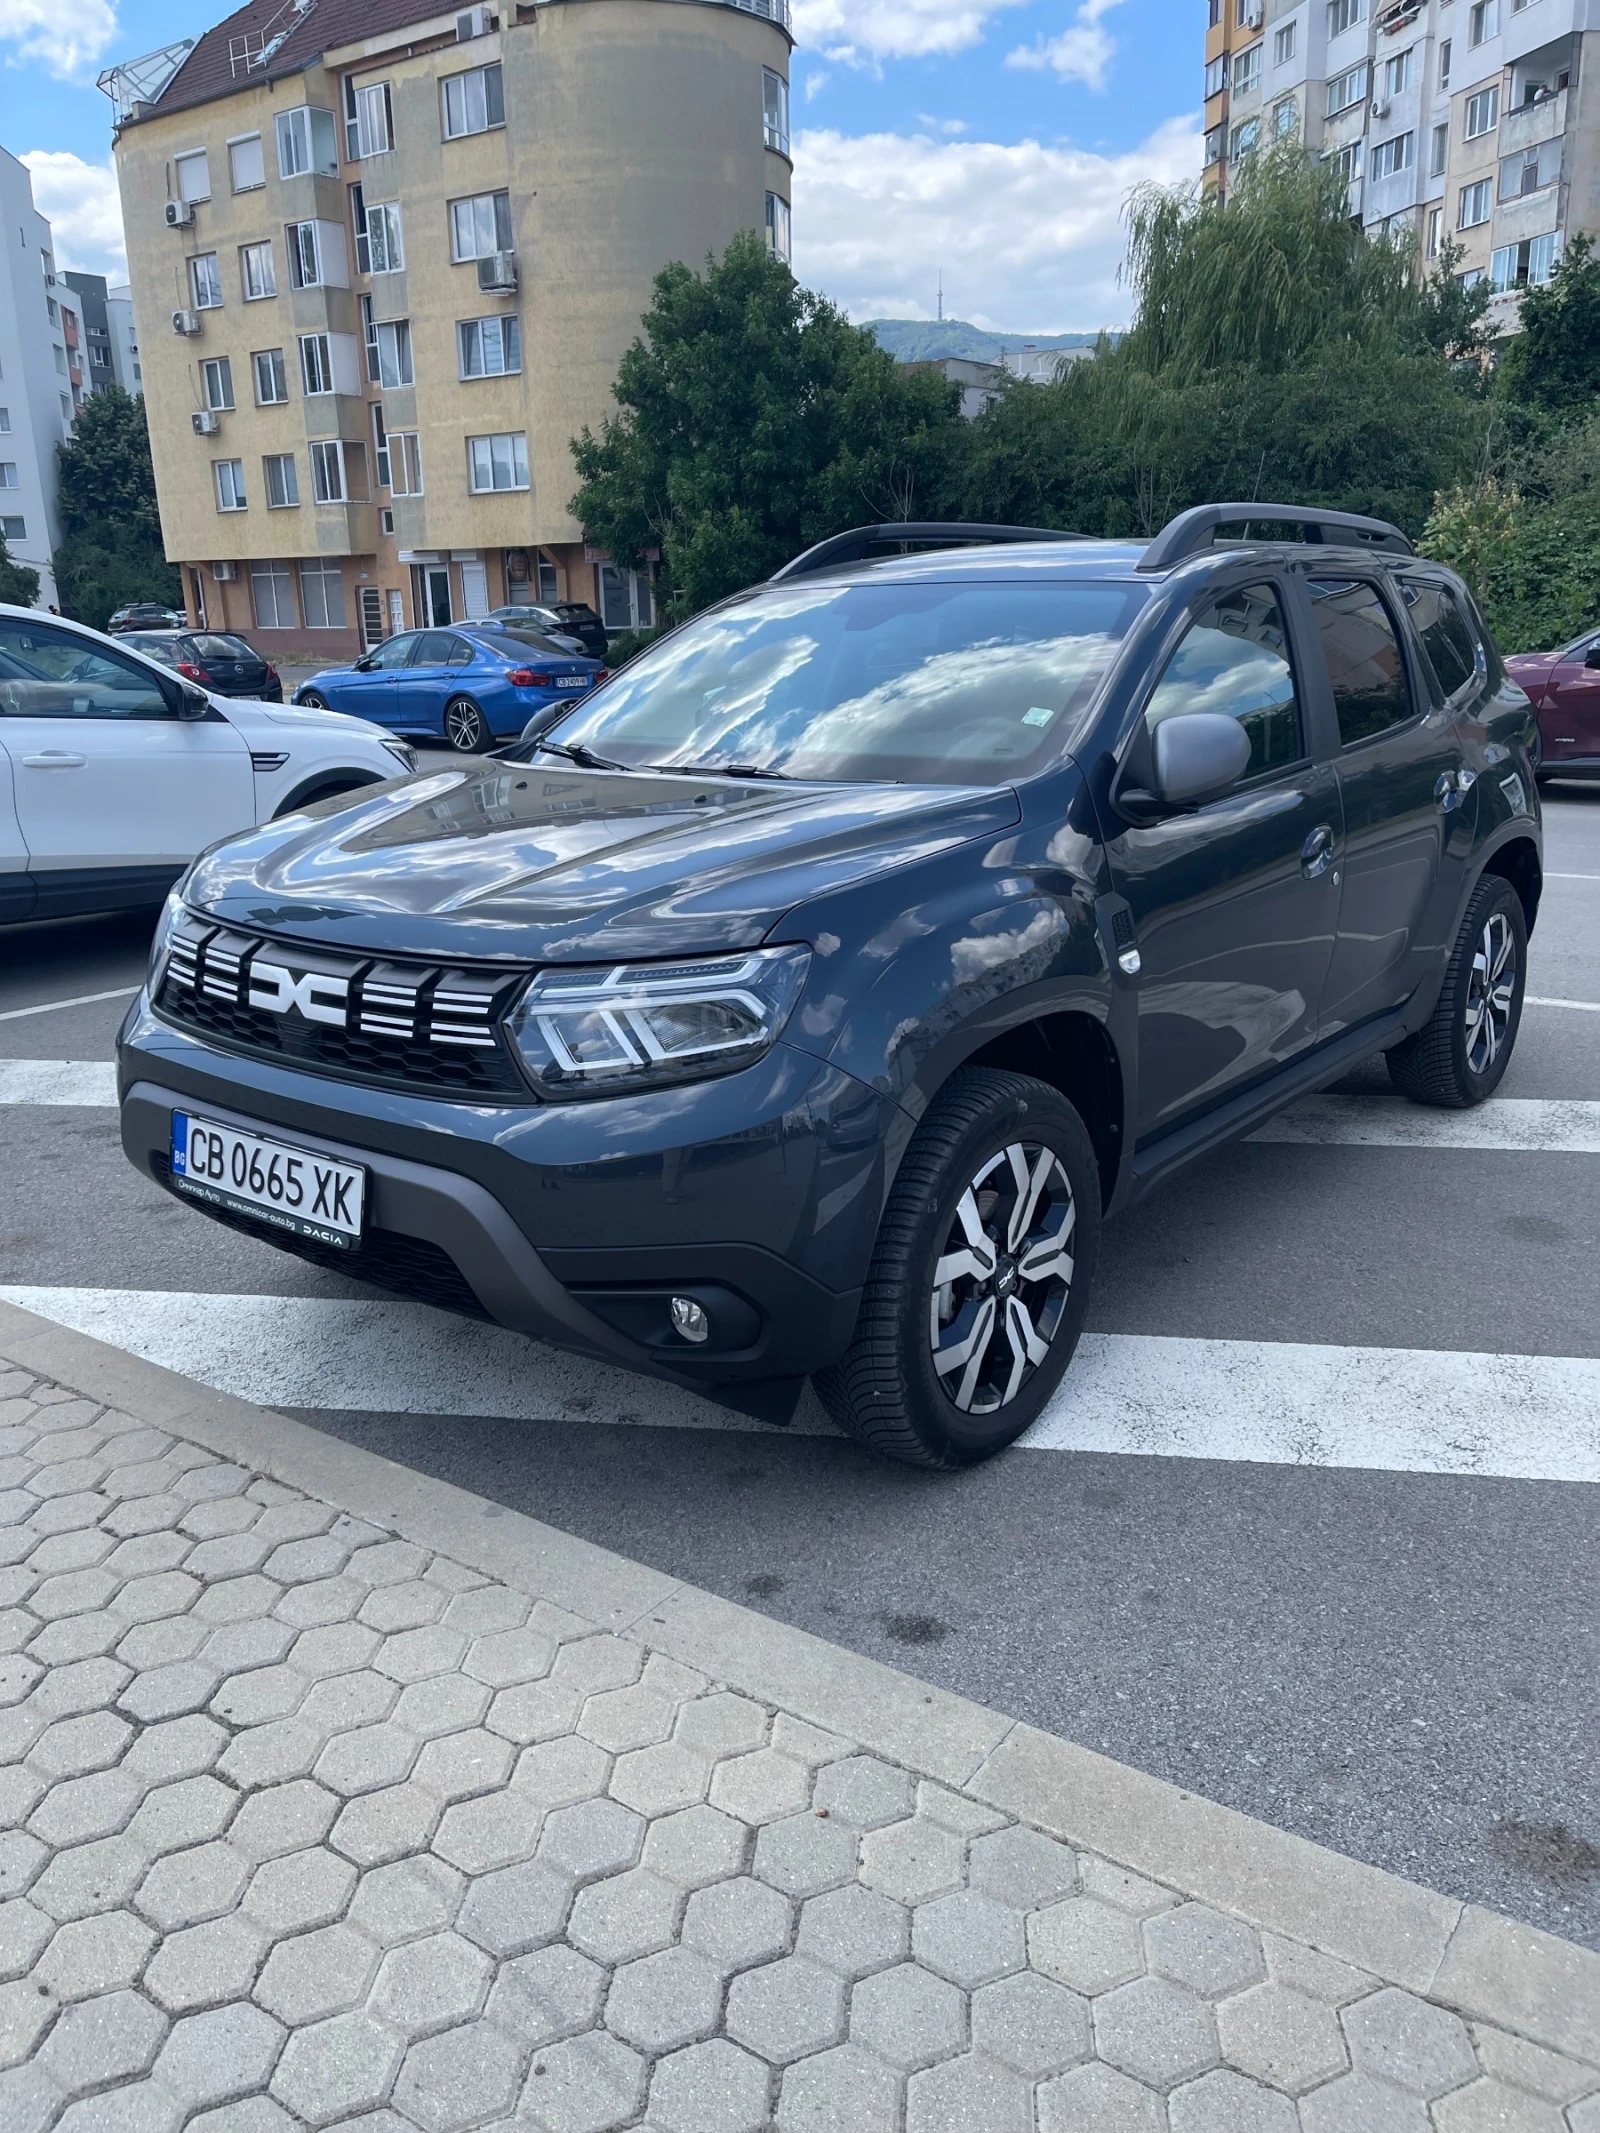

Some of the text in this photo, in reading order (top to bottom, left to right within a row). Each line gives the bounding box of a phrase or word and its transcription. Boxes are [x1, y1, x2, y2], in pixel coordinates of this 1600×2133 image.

[174, 1151, 185, 1165] BG
[191, 1128, 355, 1226] CB 0665 XK
[226, 1199, 296, 1231] www.omnicar-auto.bg
[303, 1225, 342, 1245] DACIA
